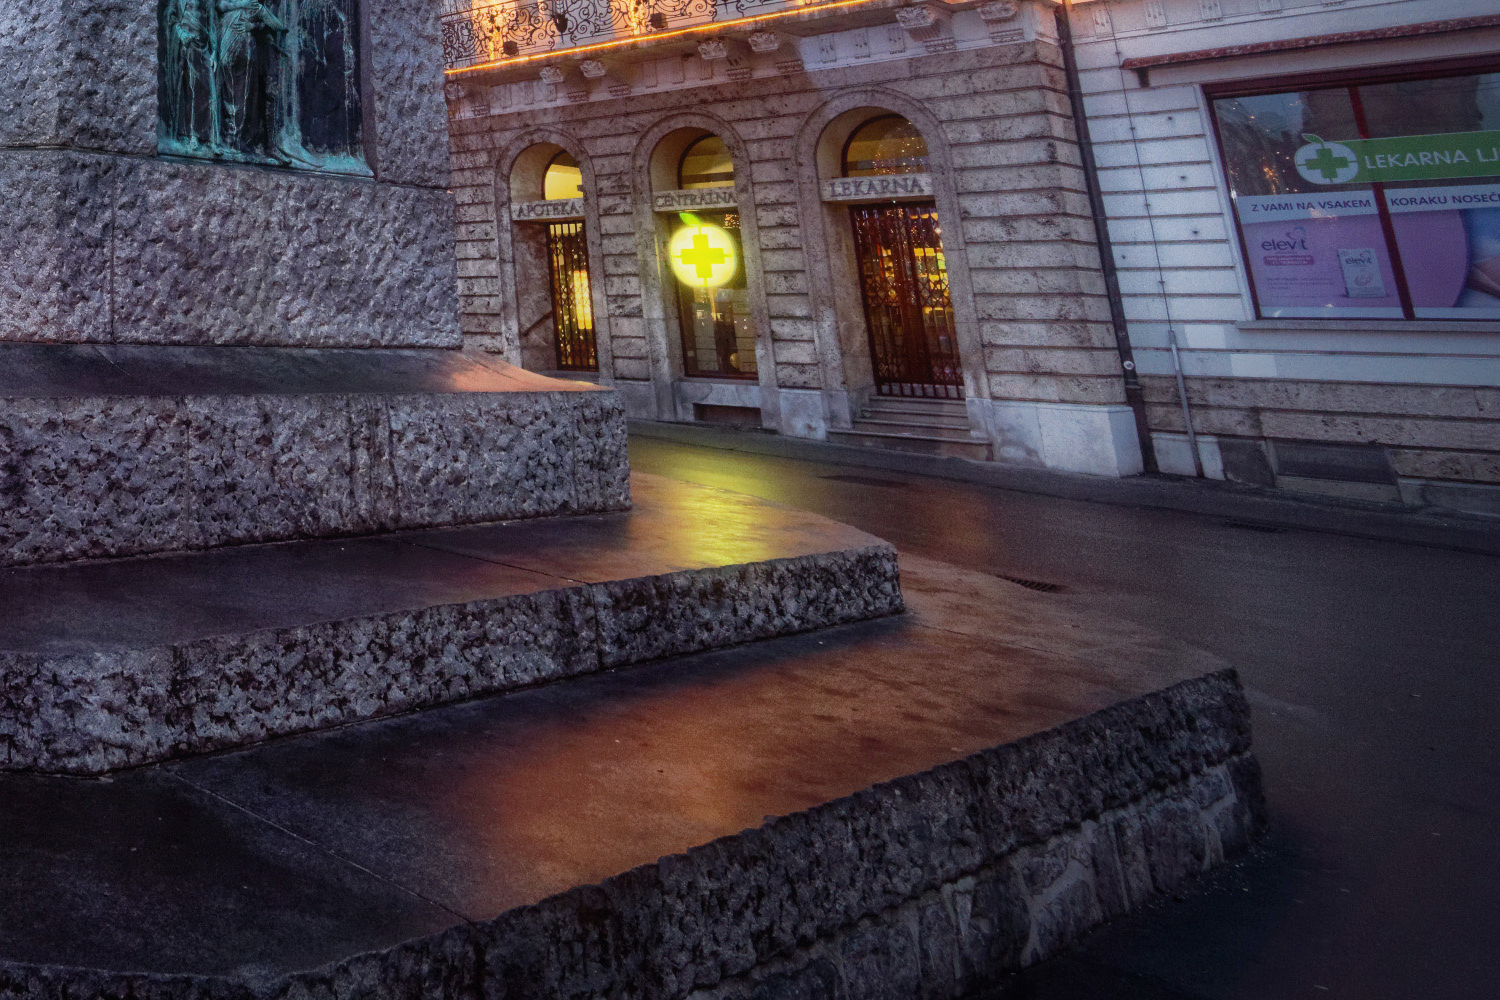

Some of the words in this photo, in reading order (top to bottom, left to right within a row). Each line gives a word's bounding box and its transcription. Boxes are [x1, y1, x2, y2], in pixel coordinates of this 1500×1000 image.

[1364, 149, 1470, 169] LEKARNA
[1476, 146, 1500, 162] LJ
[829, 177, 925, 198] LEKARNA
[655, 191, 738, 208] CENTRALNA
[1251, 204, 1259, 212] Z
[1262, 203, 1293, 212] VAMI
[1296, 201, 1315, 210] NA
[1318, 199, 1371, 209] VSAKEM
[1390, 196, 1447, 206] KORAKU
[516, 201, 581, 218] APOTEKA
